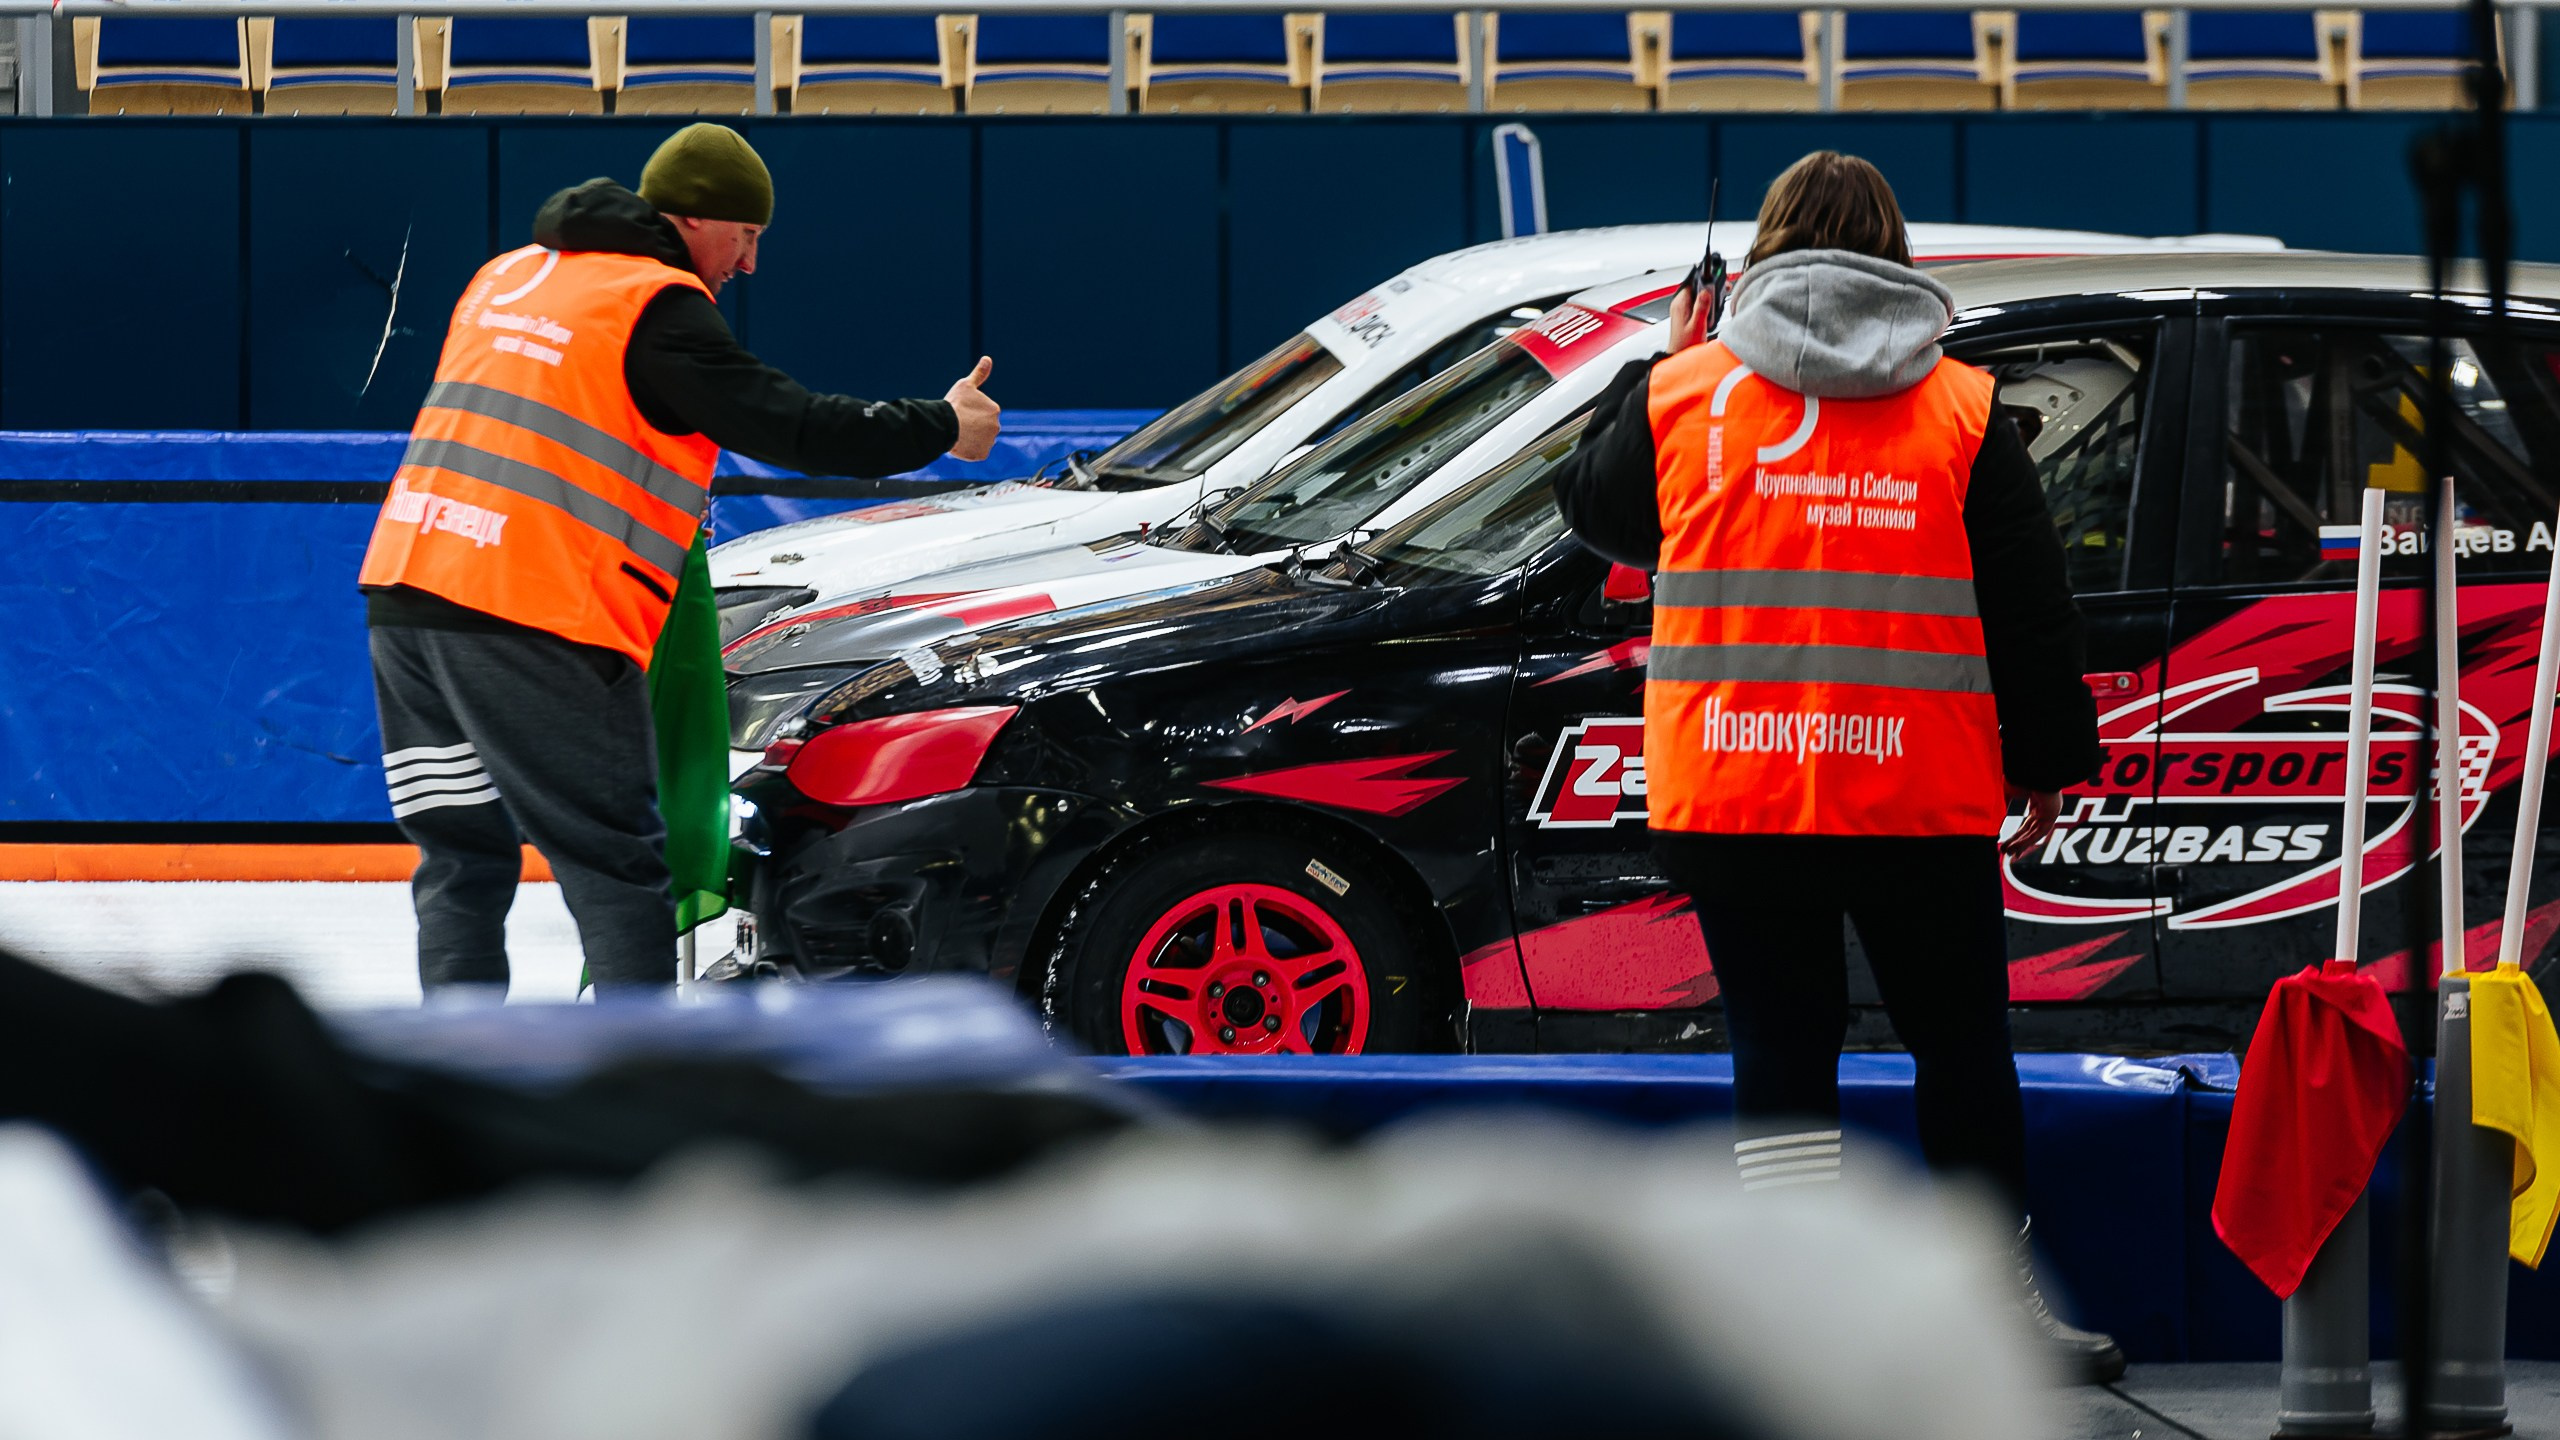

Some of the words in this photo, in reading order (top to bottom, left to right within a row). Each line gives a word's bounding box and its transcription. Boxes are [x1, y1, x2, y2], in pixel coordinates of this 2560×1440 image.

[1755, 467, 1846, 499] Крупнейший
[1850, 477, 1859, 498] в
[1862, 471, 1918, 505] Сибири
[1806, 502, 1852, 530] музей
[1856, 505, 1916, 531] техники
[2380, 524, 2516, 558] Зацев
[1702, 696, 1905, 765] Новокузнецк
[2040, 824, 2330, 865] KUZBASS
